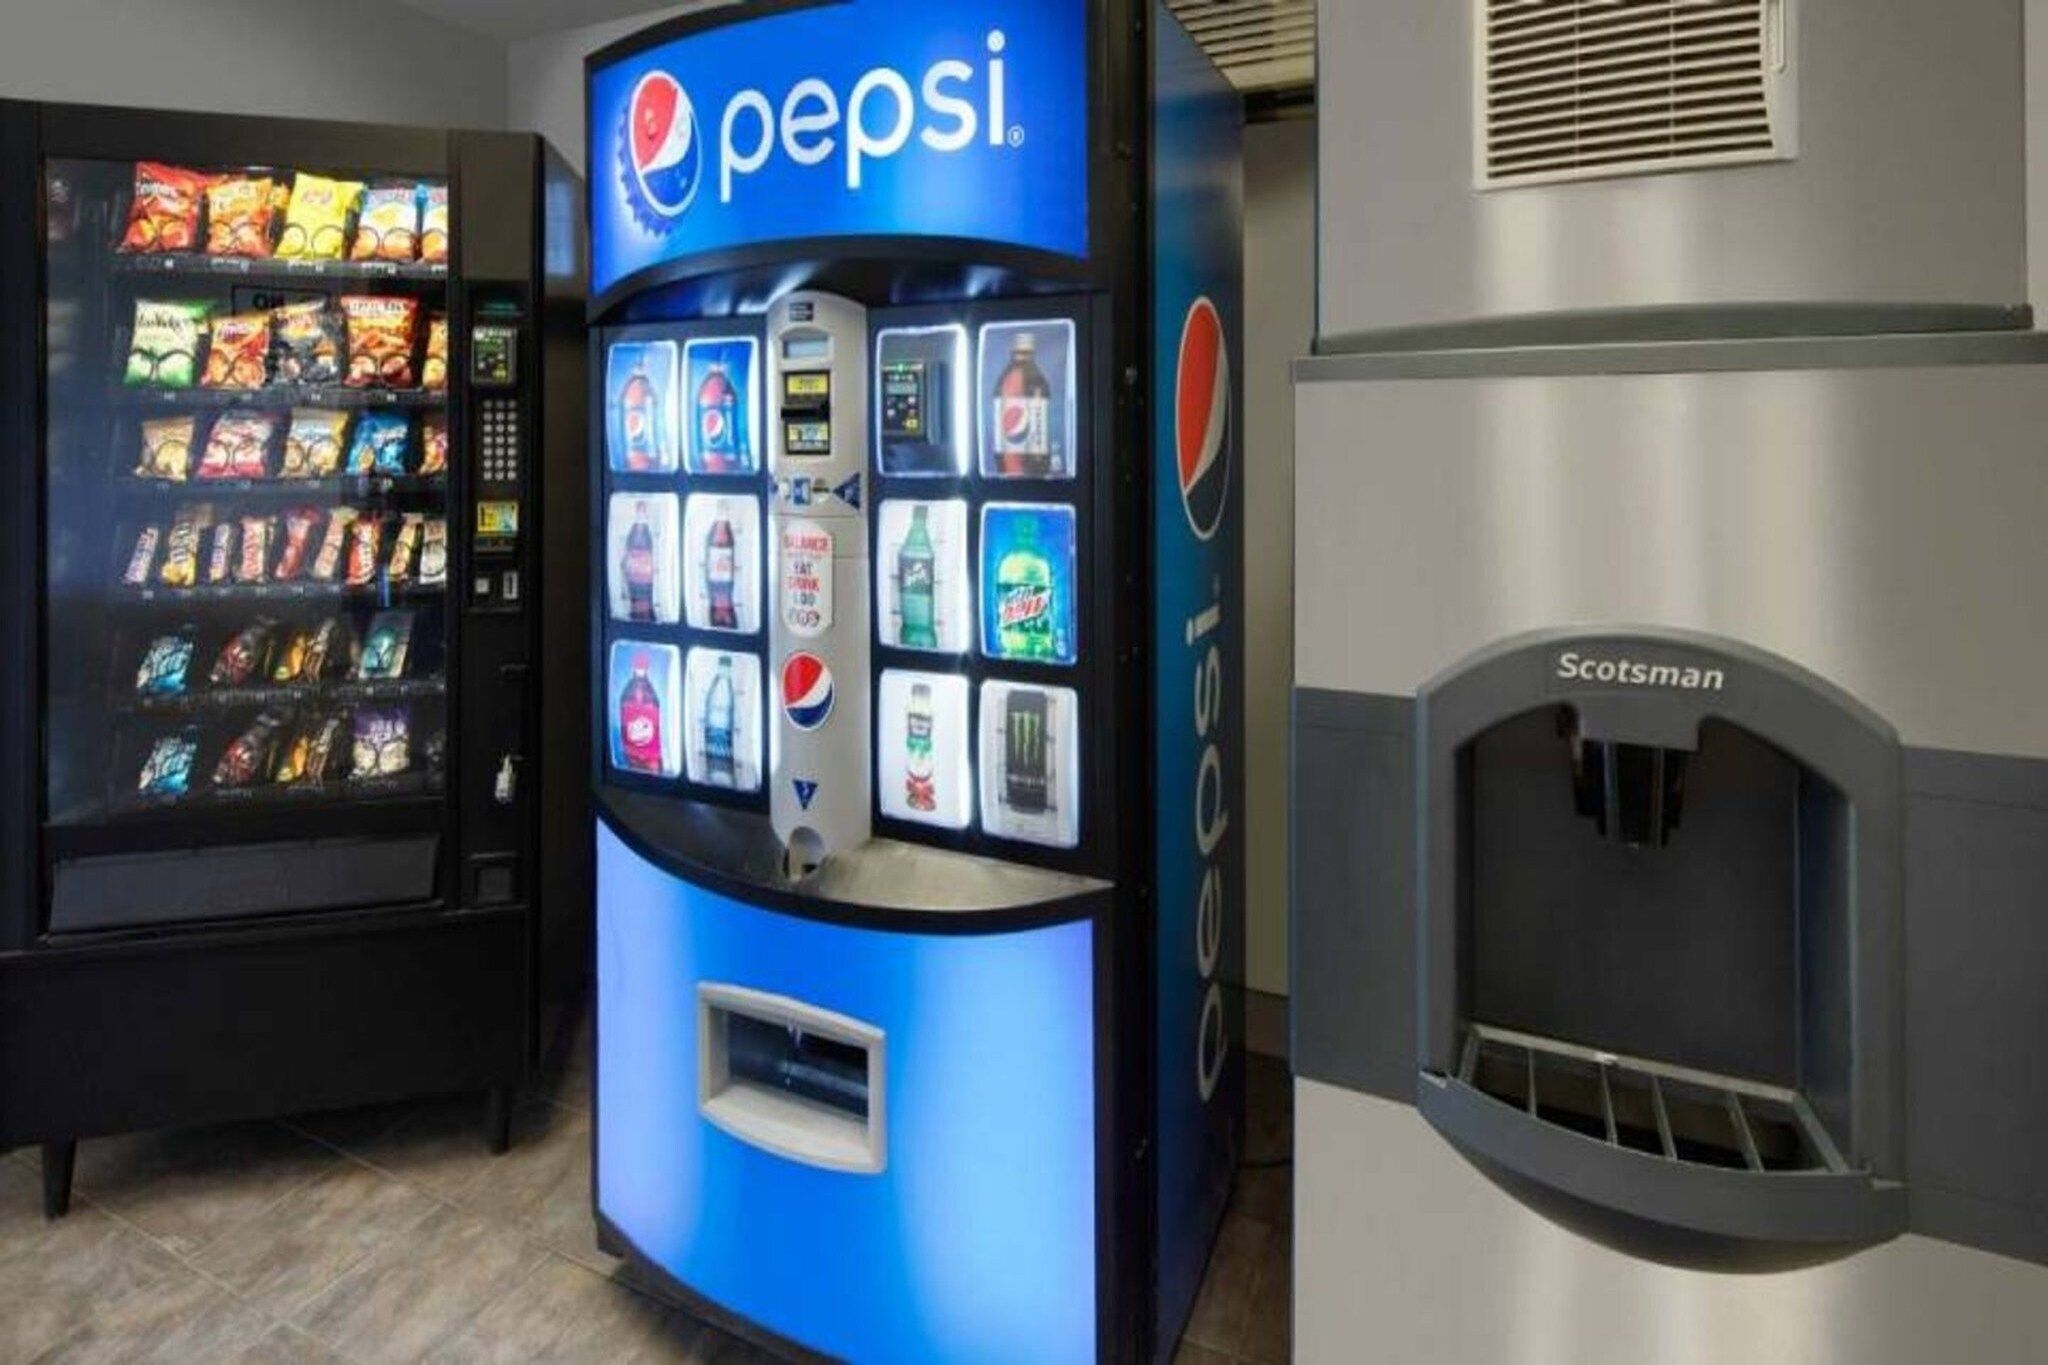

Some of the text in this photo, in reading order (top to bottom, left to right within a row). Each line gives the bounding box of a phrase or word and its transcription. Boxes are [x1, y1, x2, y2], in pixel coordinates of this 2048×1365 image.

[719, 29, 1006, 204] pepsi
[1556, 652, 1725, 691] Scotsman
[1185, 605, 1230, 1102] pepsi
